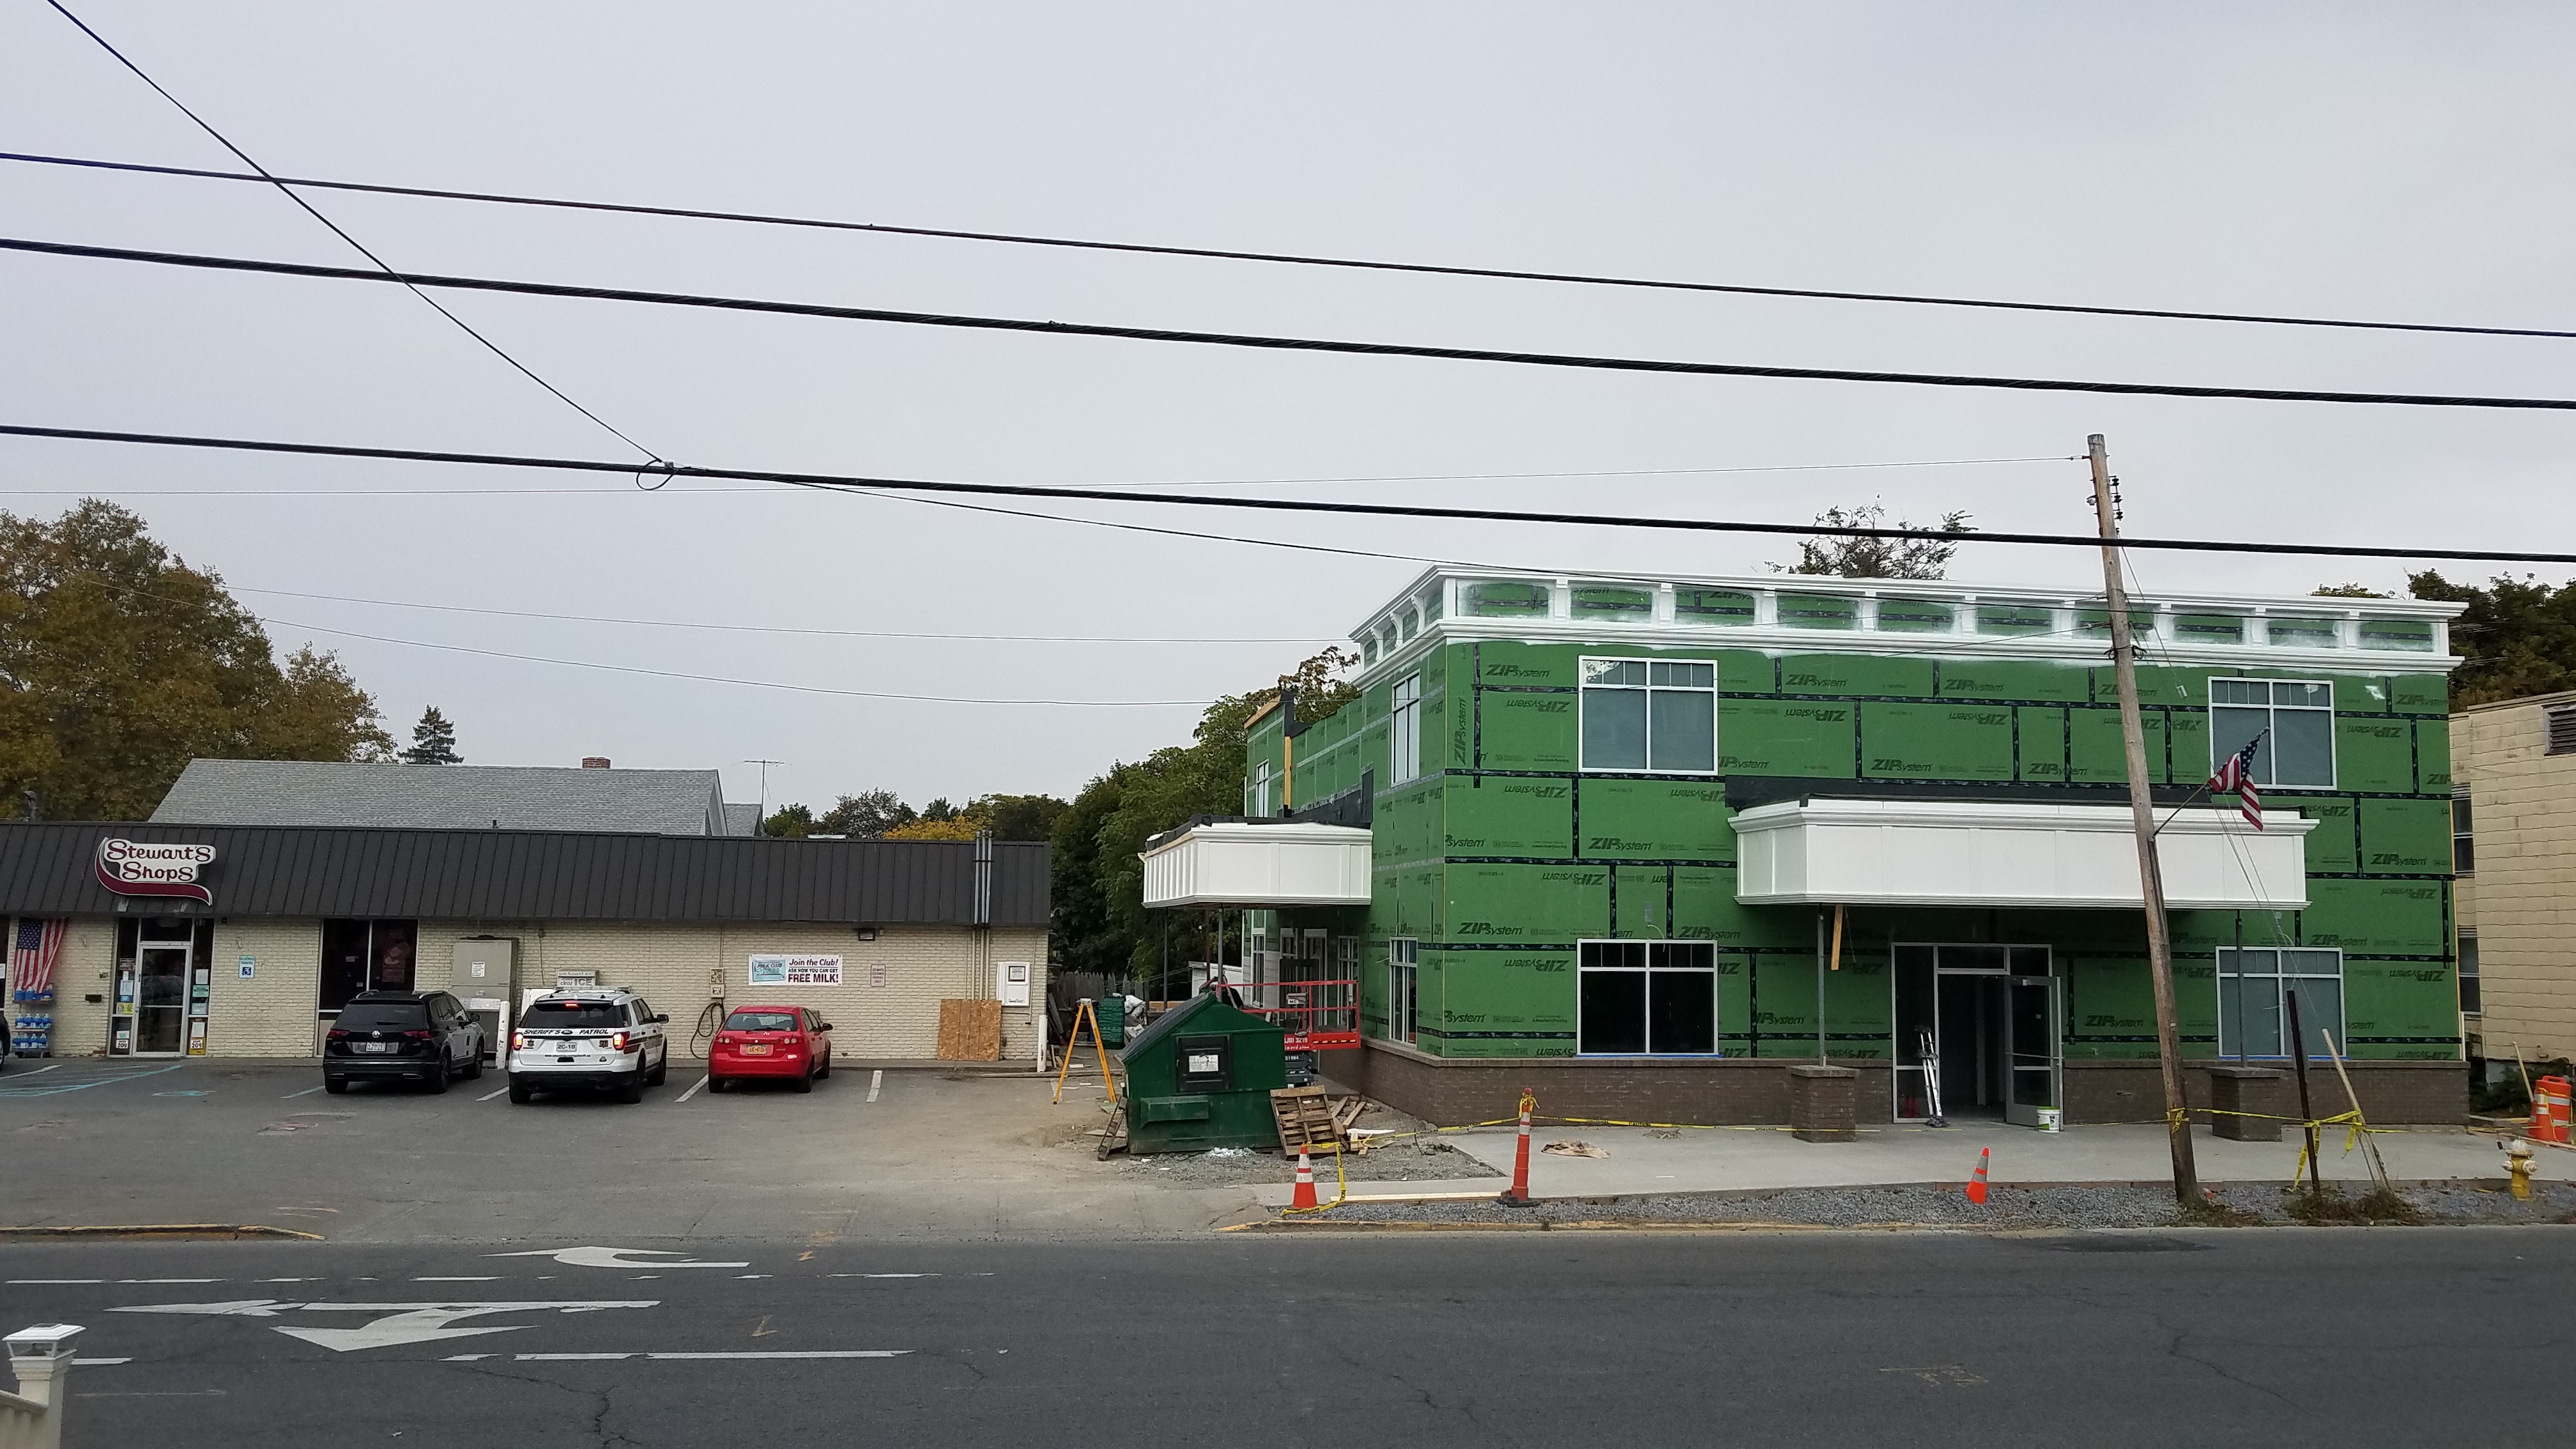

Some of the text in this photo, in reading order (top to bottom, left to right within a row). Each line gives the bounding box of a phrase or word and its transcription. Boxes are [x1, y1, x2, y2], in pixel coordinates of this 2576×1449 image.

[107, 840, 211, 862] Stewart's
[122, 861, 194, 881] Shops
[574, 977, 592, 986] ICE
[788, 974, 839, 983] FREE MILK!
